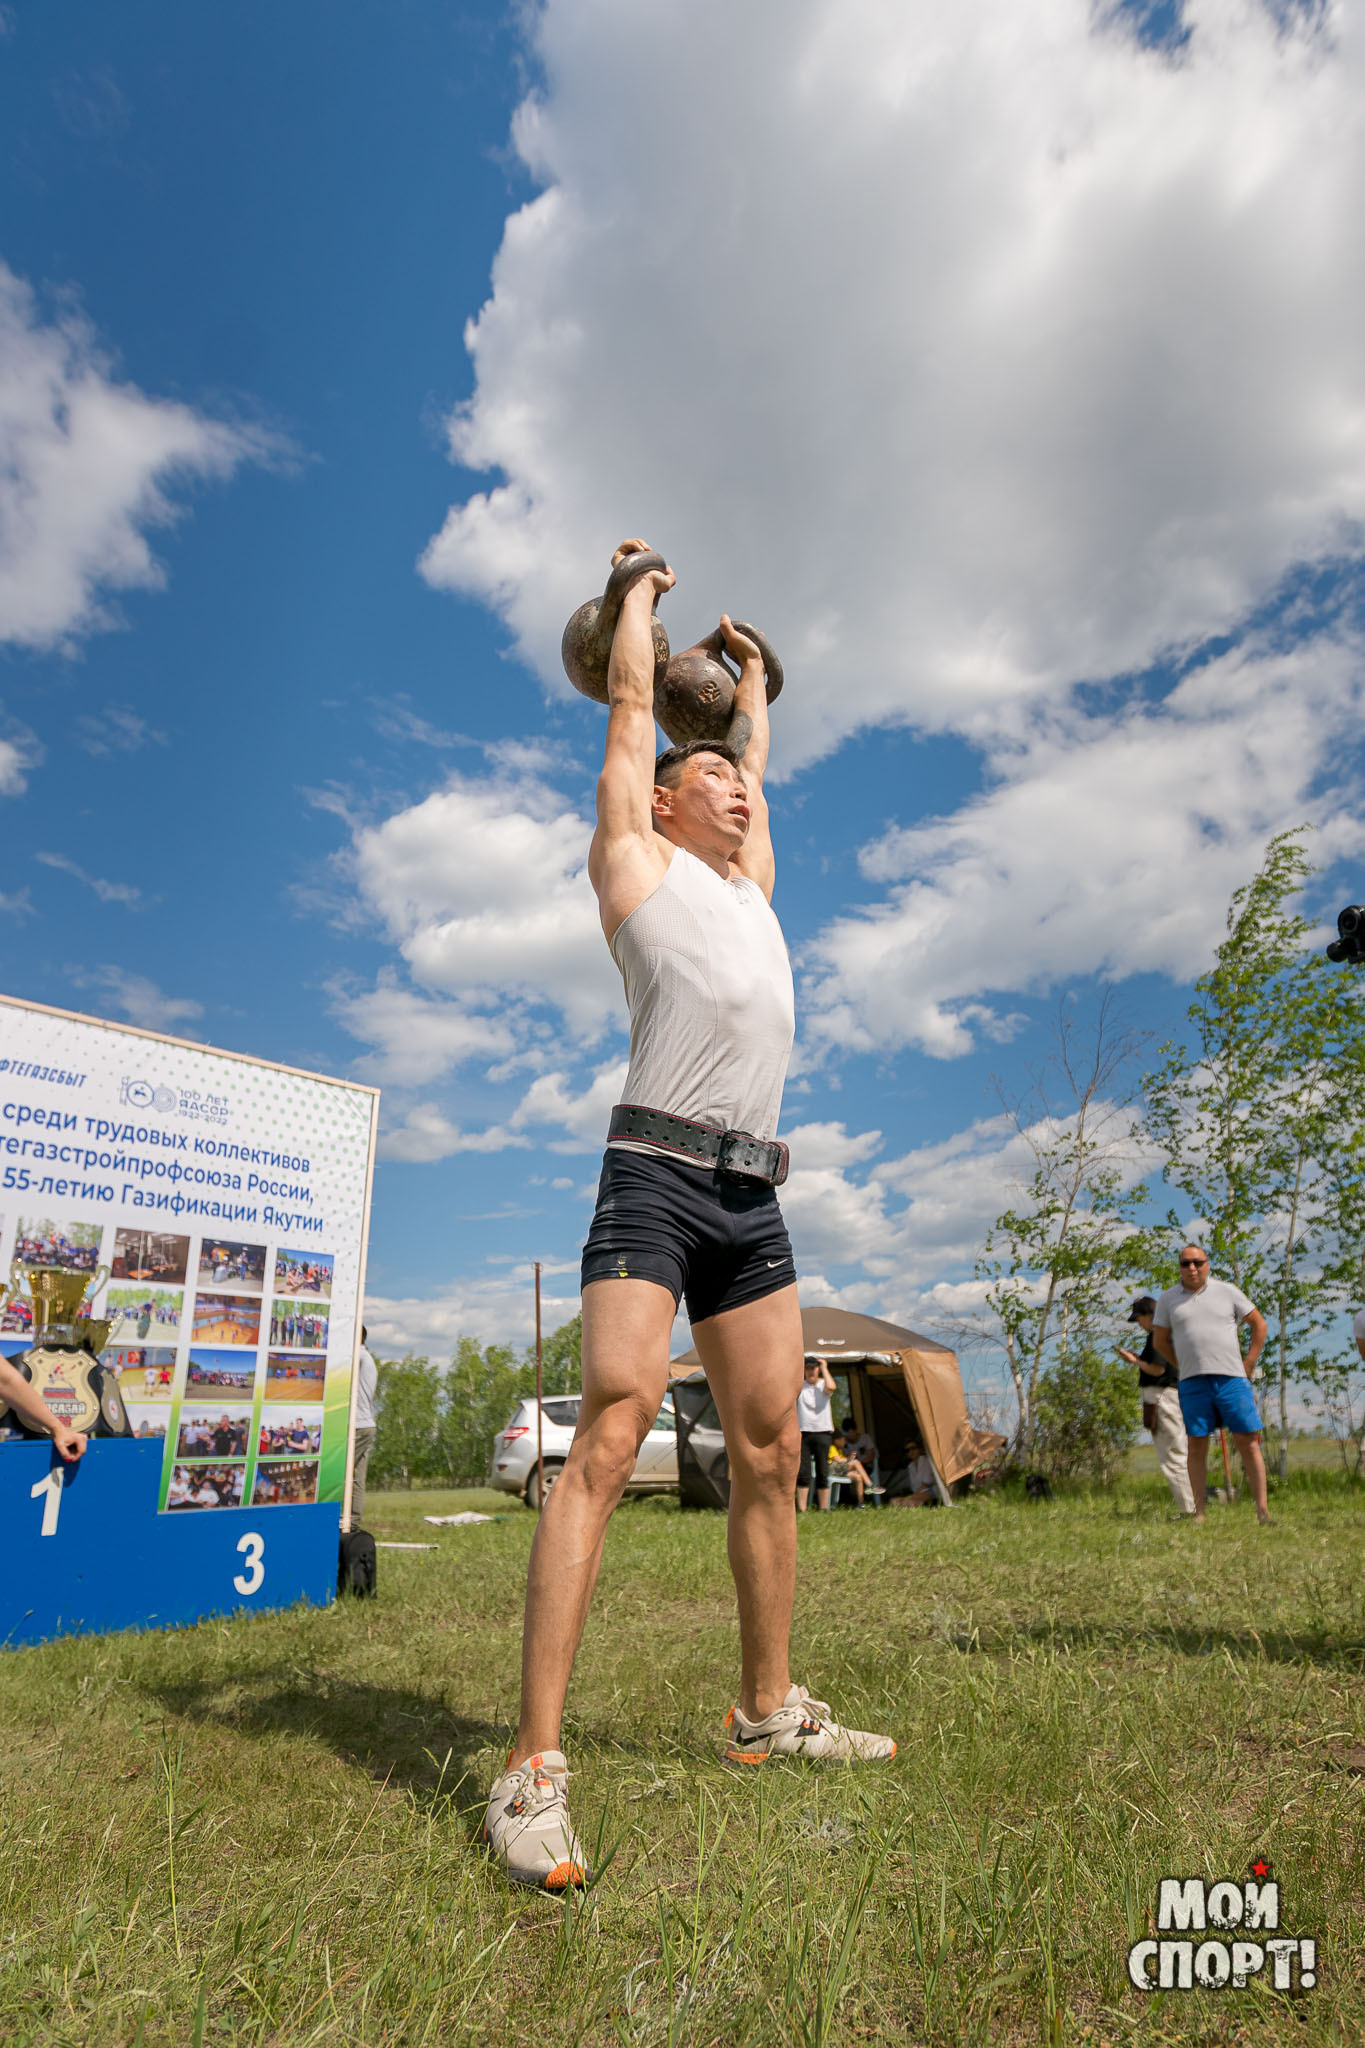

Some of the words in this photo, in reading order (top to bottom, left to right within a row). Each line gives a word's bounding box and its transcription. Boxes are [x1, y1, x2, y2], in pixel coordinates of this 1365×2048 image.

[179, 1099, 229, 1116] ЯАССР
[180, 1089, 201, 1101] 100
[206, 1094, 229, 1106] ЛЕТ
[3, 1102, 78, 1131] среди
[85, 1117, 188, 1150] трудовых
[194, 1137, 310, 1173] коллективов
[2, 1166, 114, 1202] 55-летию
[121, 1184, 257, 1222] Газификации
[263, 1206, 324, 1233] Якутии
[247, 1173, 314, 1206] России,
[30, 1466, 64, 1537] 1
[232, 1532, 265, 1596] 3
